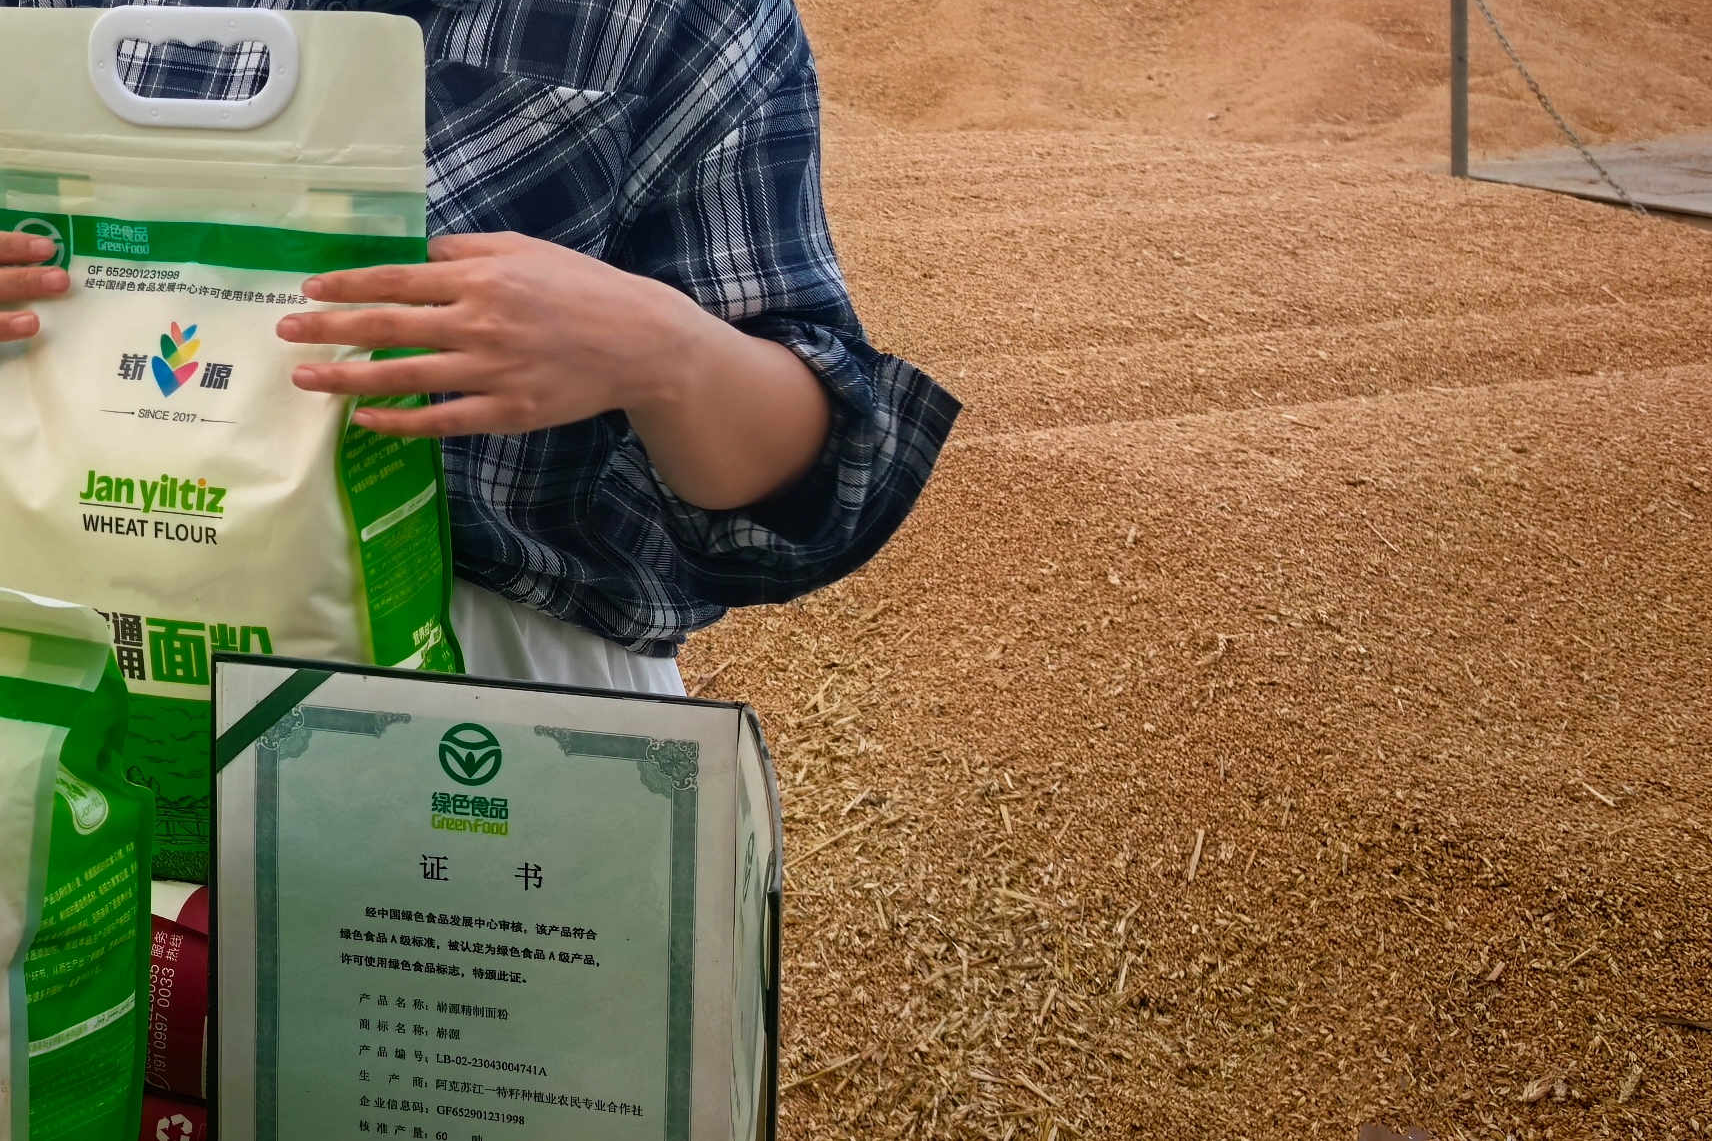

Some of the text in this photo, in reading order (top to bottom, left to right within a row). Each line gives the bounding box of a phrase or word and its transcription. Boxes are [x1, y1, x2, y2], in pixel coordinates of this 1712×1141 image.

[96, 222, 148, 243] 绿色食品
[87, 265, 180, 280] GF 652901231998
[137, 408, 197, 423] SINCE 2017
[82, 513, 218, 546] WHEAT FLOUR
[431, 791, 509, 820] 绿色食品
[157, 967, 175, 1008] 0033
[153, 1012, 168, 1050] 0997
[435, 1053, 547, 1077] LB-02-23043004741A
[436, 1104, 525, 1126] GF652901231998
[435, 1131, 448, 1141] 60
